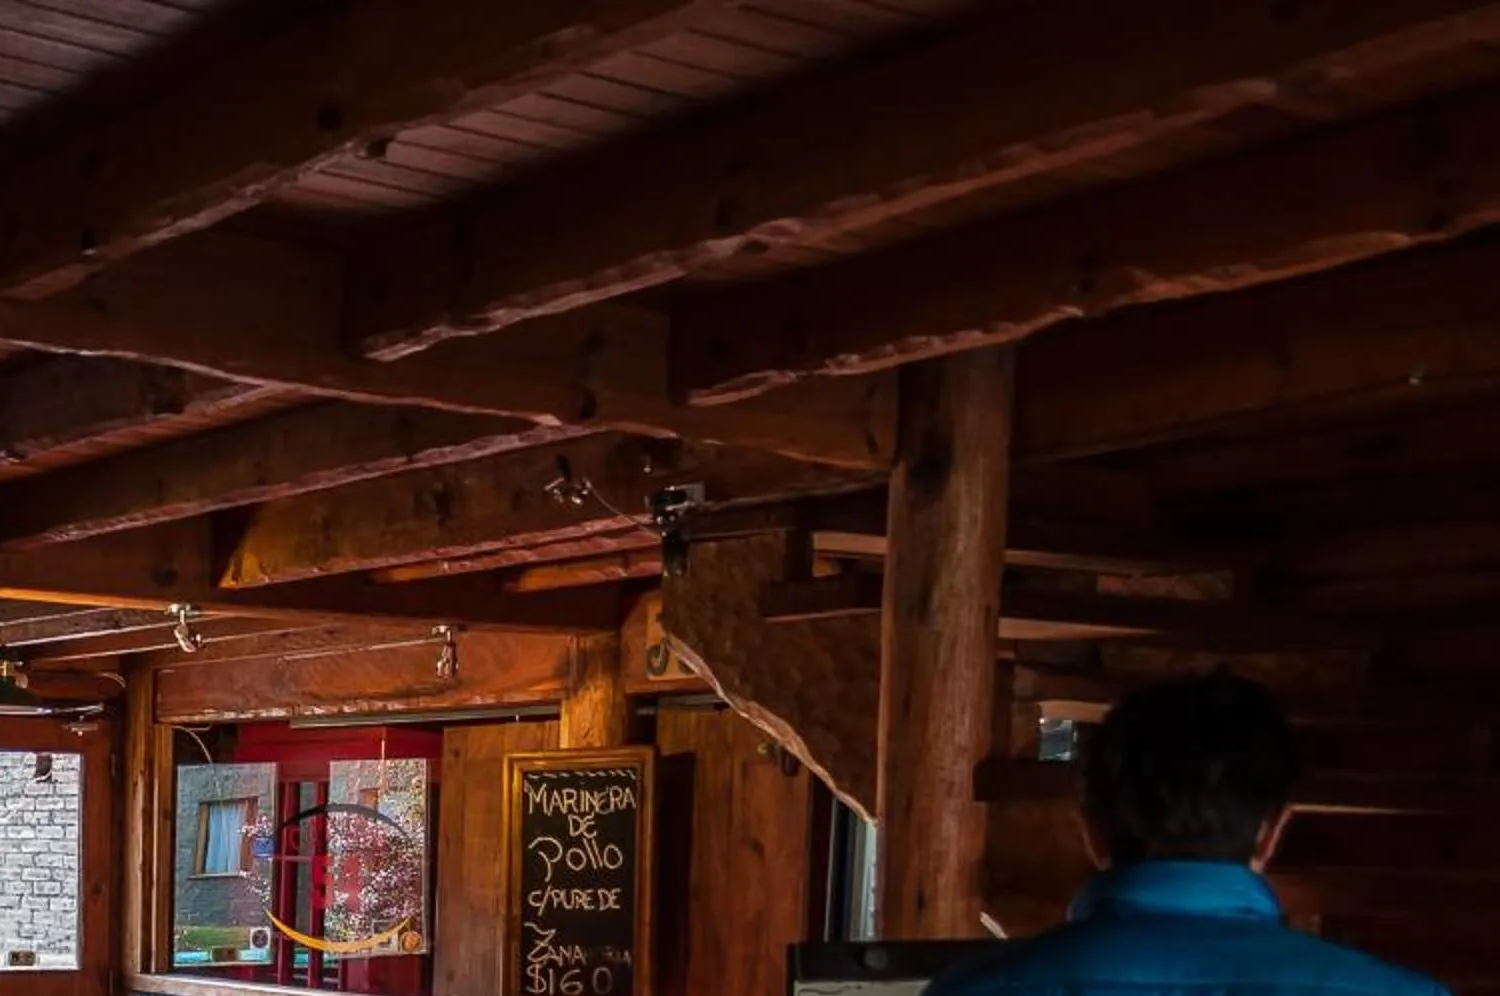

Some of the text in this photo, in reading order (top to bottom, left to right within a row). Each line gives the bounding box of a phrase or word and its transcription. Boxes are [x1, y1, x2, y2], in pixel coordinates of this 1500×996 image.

[525, 780, 637, 816] MARINERA
[567, 813, 598, 839] DE
[598, 888, 621, 912] DE
[526, 963, 613, 996] $160
